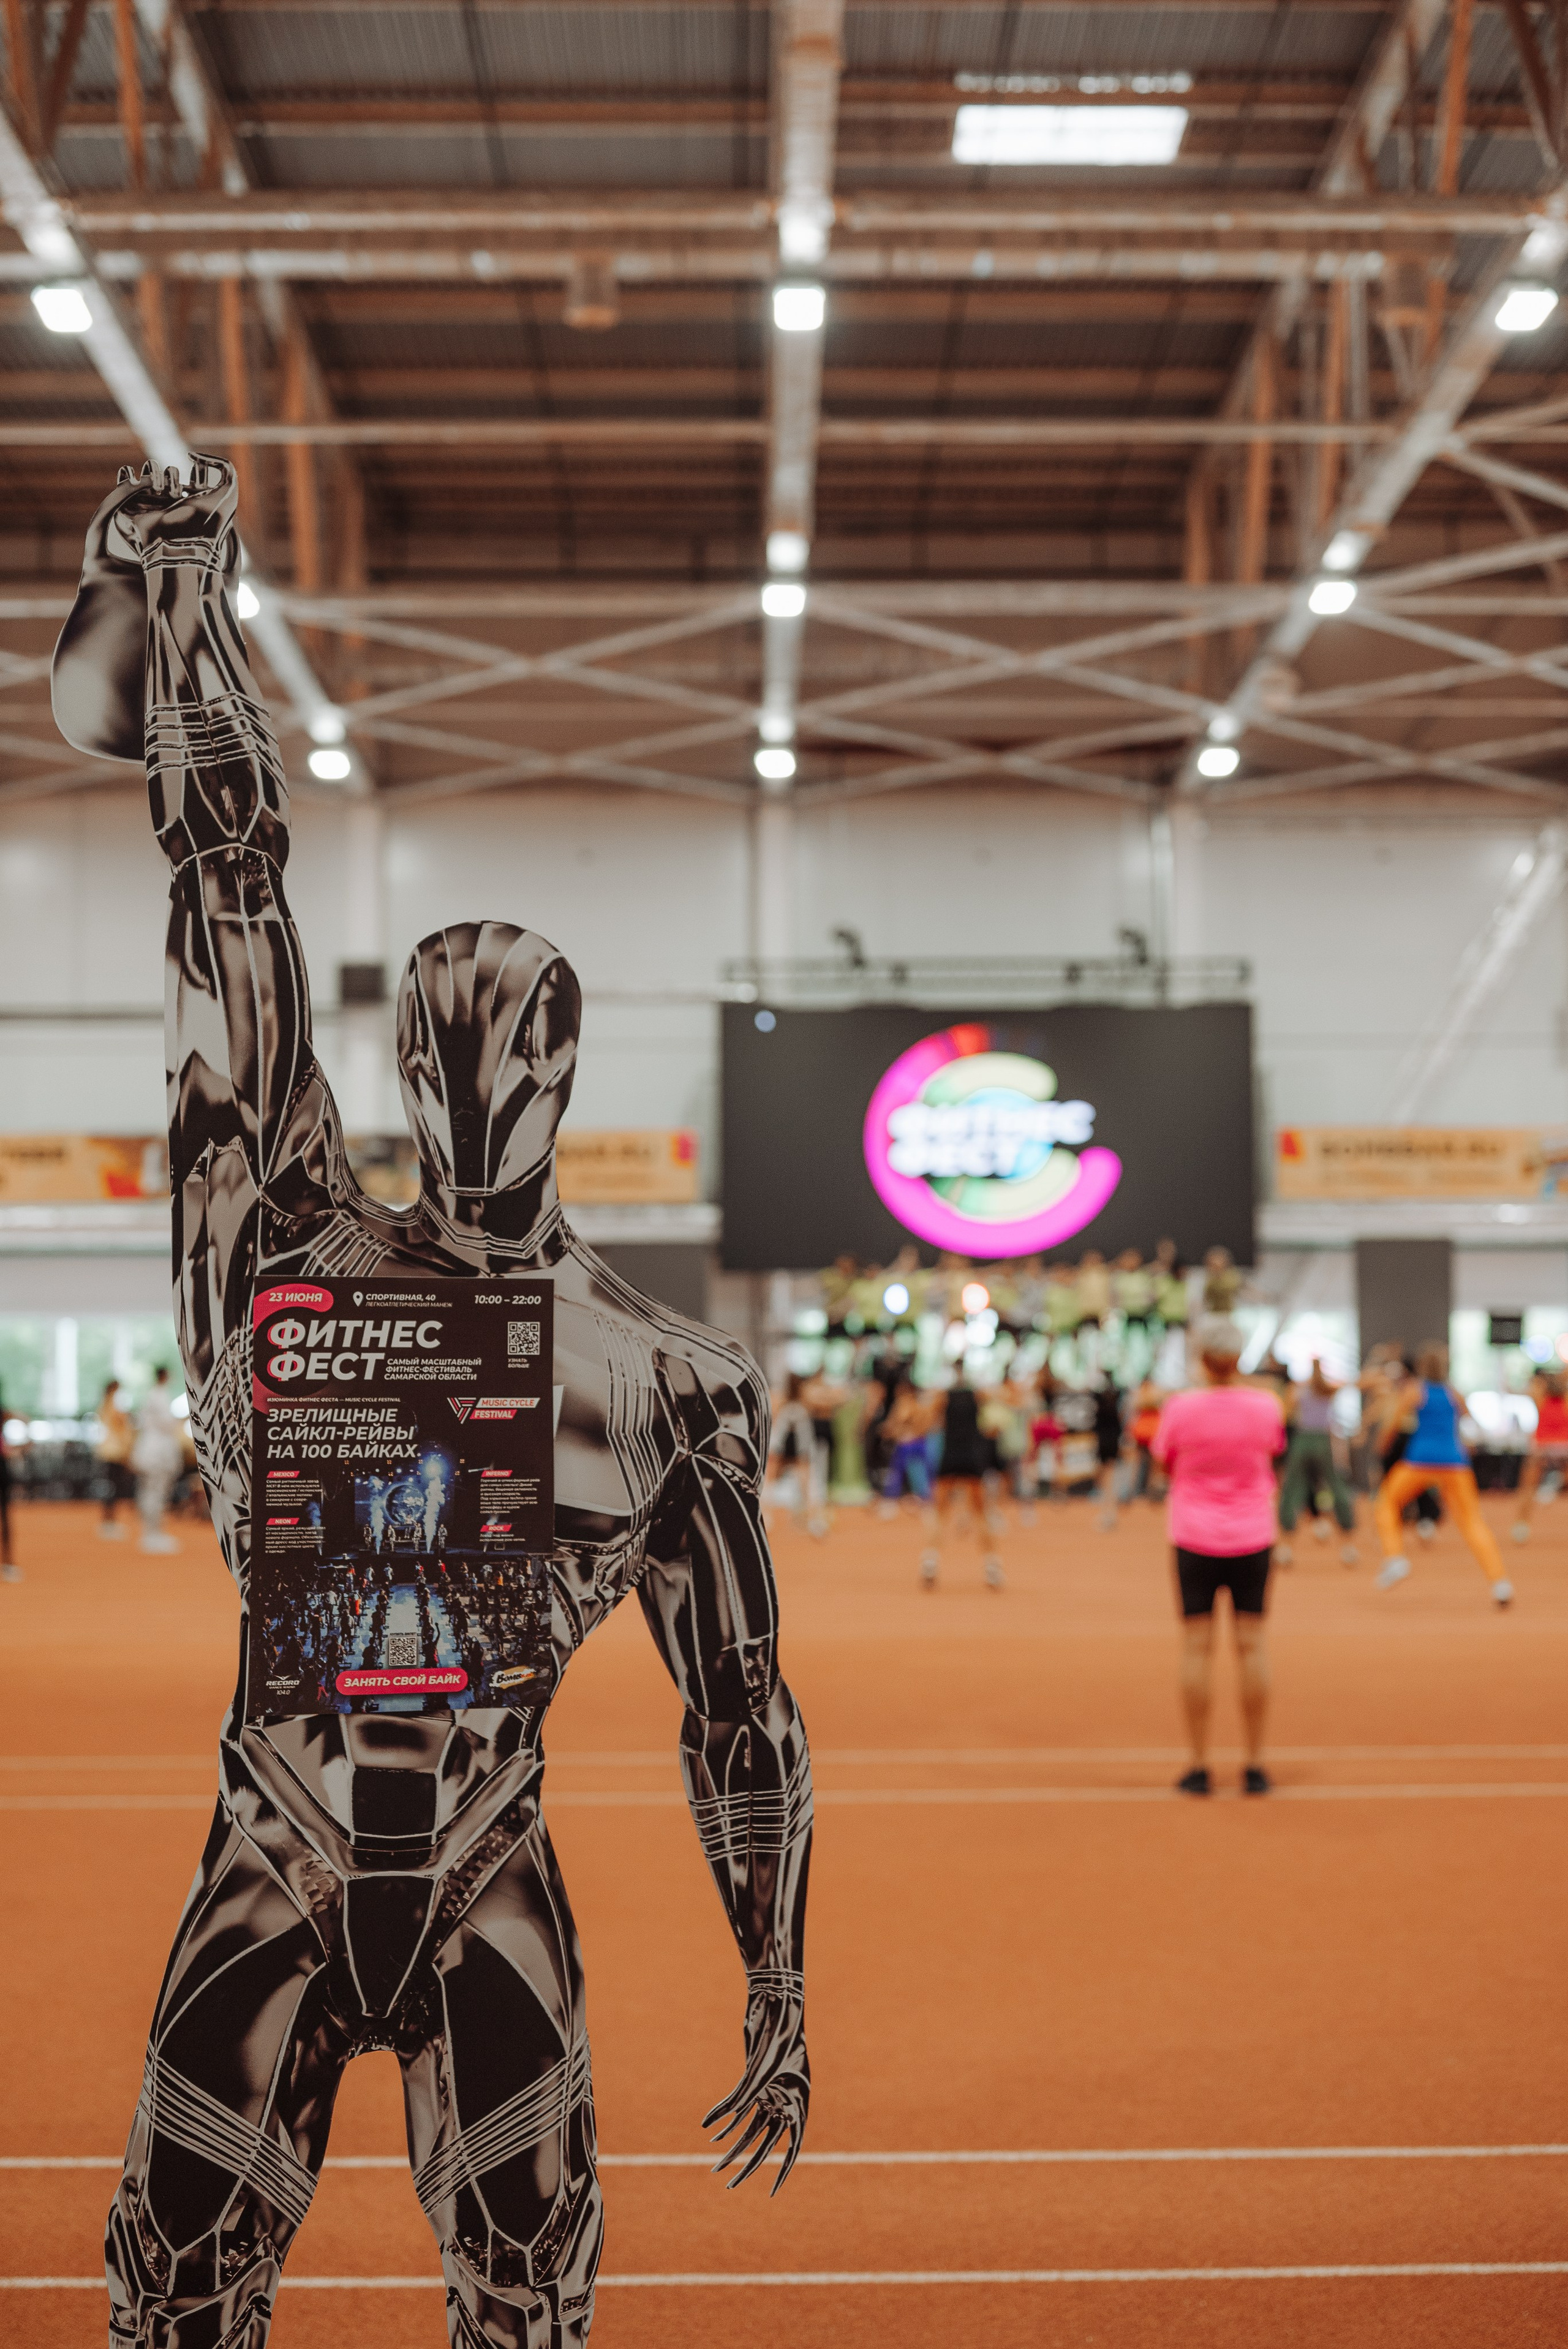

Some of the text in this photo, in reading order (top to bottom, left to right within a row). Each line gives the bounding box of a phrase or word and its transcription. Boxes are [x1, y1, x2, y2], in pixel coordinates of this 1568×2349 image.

[269, 1292, 322, 1302] 23 ИЮНЯ
[475, 1295, 502, 1304] 10:00
[512, 1295, 541, 1305] 22:00
[267, 1319, 443, 1349] ФИТНЕС
[267, 1351, 385, 1382] ФЕСТ
[266, 1408, 398, 1425] ЗРЕЛИЩНЫЕ
[267, 1422, 415, 1440] САЙКЛ-РЕЙВЫ
[266, 1441, 421, 1458] НА 100 БАЙКАХ.
[344, 1673, 462, 1687] ЗАНЯТЬ СВОЙ БАЙК
